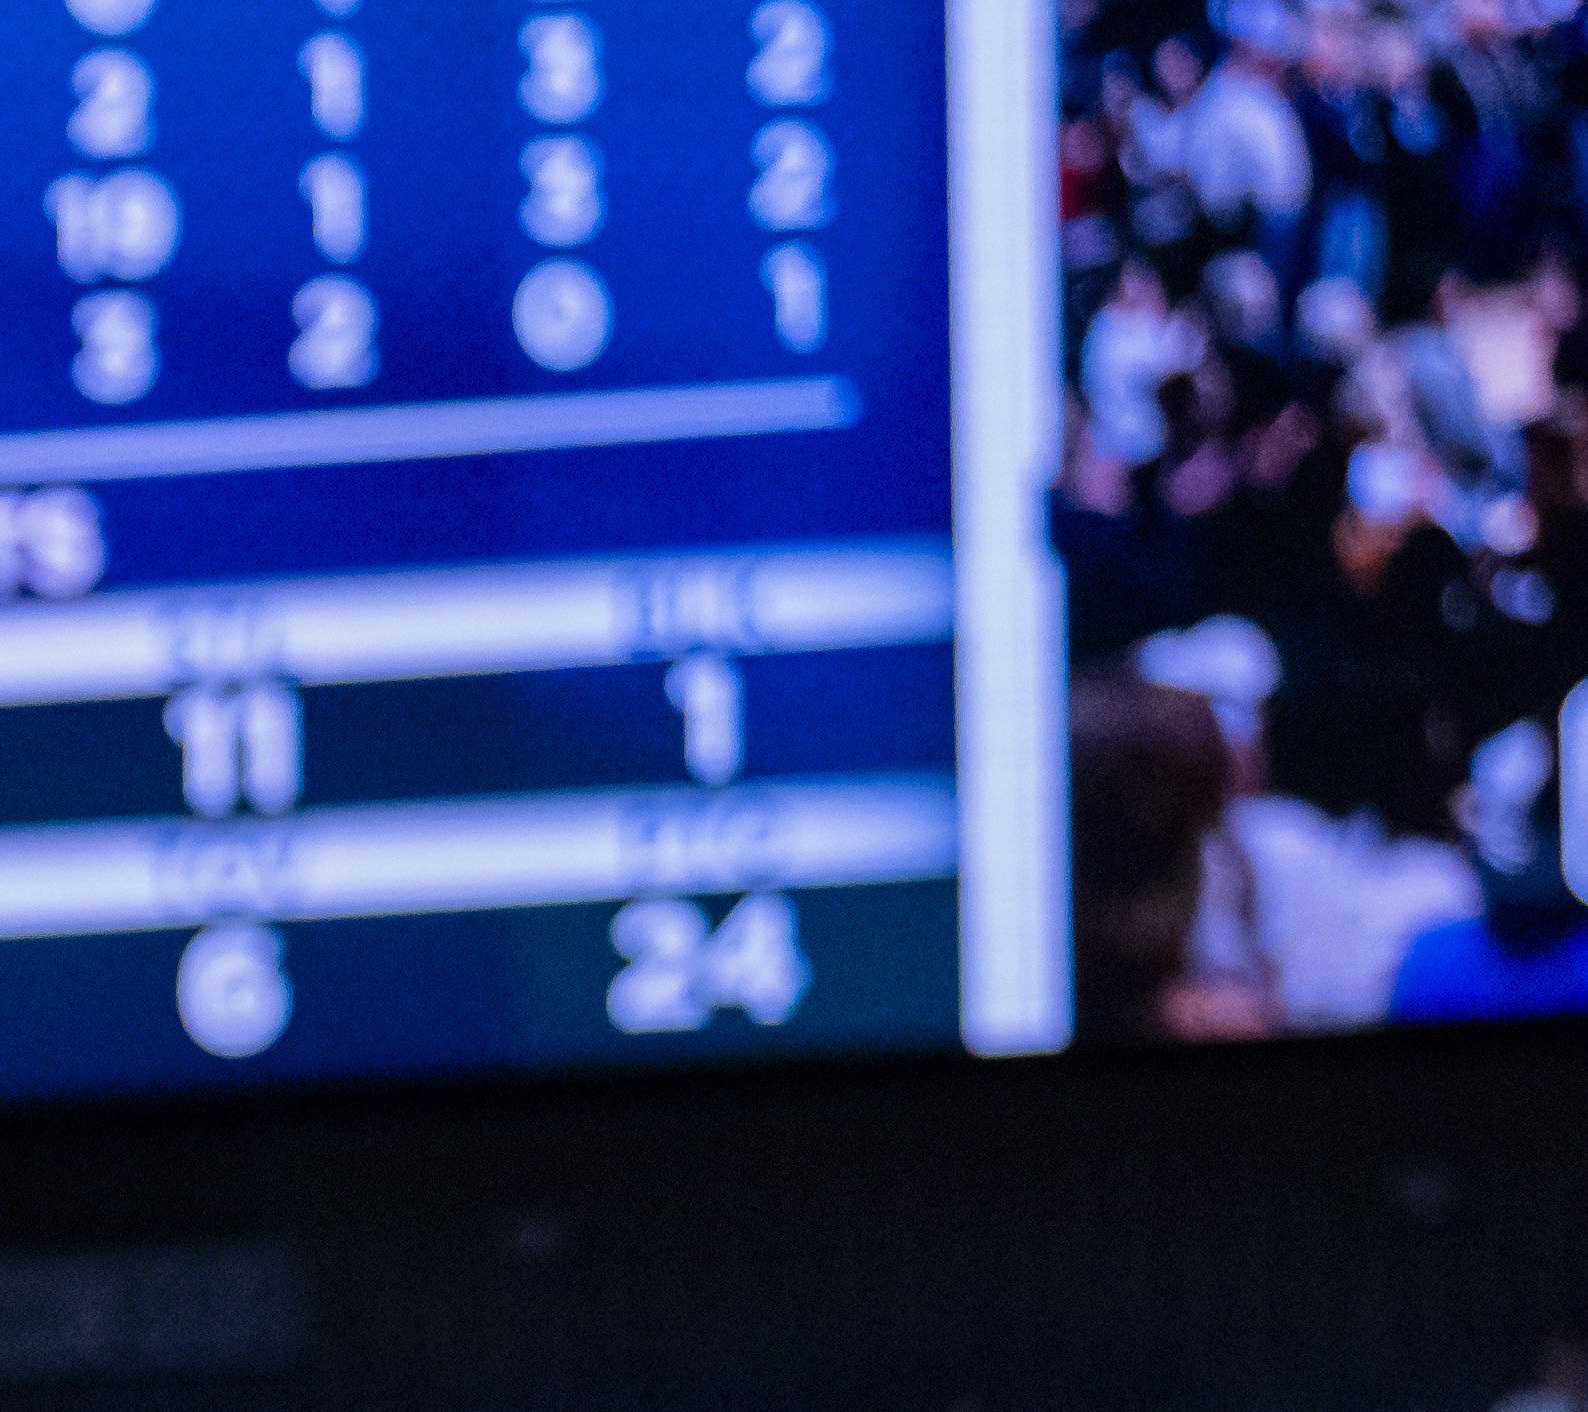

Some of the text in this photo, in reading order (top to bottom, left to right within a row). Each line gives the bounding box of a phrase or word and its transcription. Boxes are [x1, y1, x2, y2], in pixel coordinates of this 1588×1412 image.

[71, 46, 153, 160] 2
[299, 30, 363, 140] 1
[749, 1, 830, 106] 2
[301, 152, 364, 262] 1
[750, 118, 831, 231] 2
[289, 274, 377, 388] 2
[763, 242, 826, 352] 1
[163, 684, 301, 816] 11
[666, 652, 744, 786] 1
[178, 920, 291, 1058] 6
[608, 893, 809, 1032] 24
